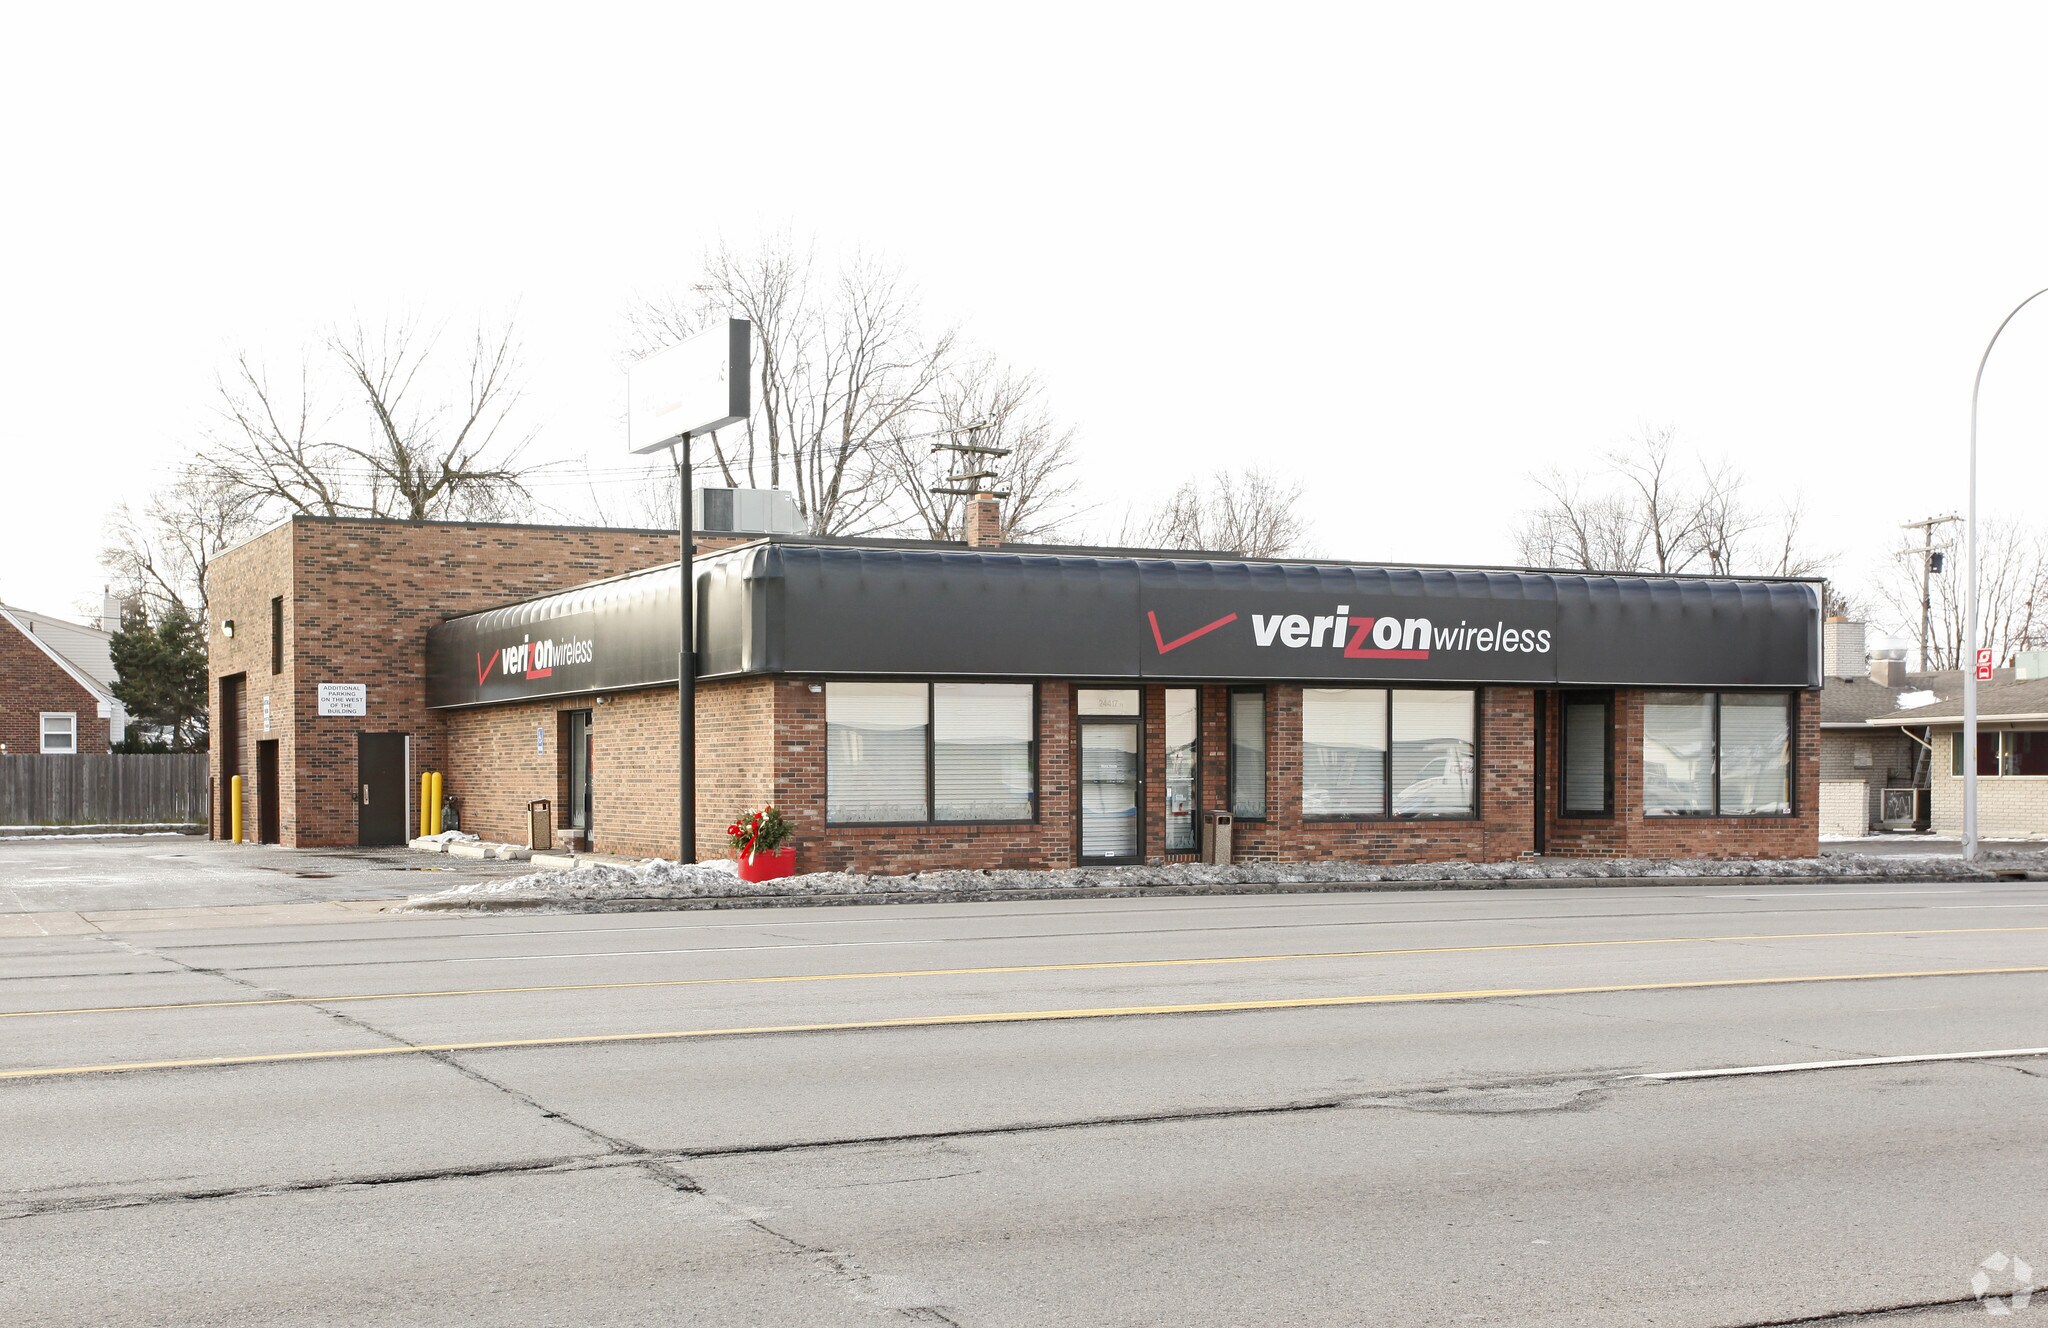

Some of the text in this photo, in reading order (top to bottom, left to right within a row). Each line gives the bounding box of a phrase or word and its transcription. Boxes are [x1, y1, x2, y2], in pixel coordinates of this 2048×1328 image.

[502, 634, 592, 680] verizon wireless
[1252, 605, 1551, 660] verizon wireless
